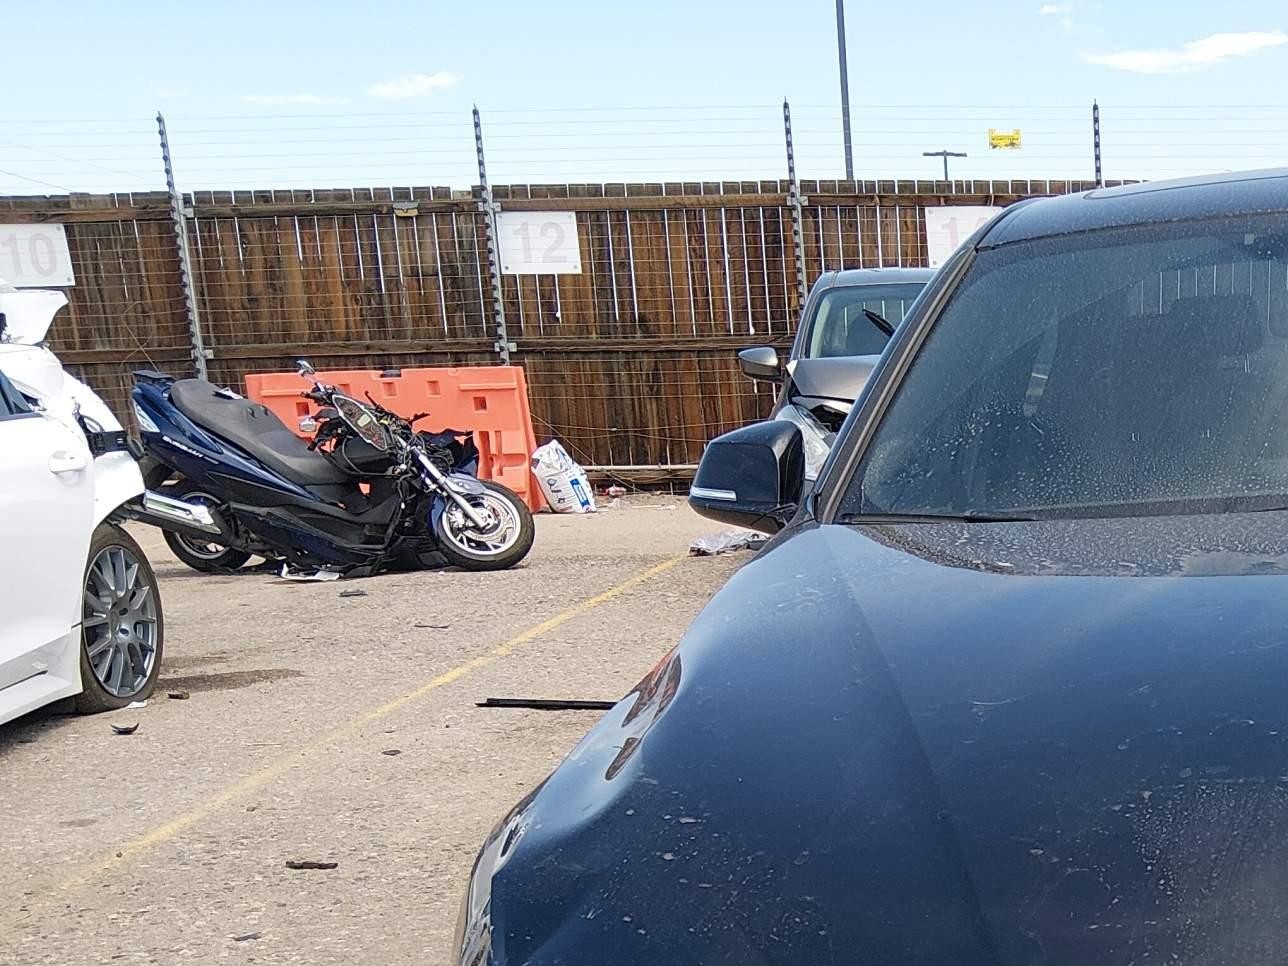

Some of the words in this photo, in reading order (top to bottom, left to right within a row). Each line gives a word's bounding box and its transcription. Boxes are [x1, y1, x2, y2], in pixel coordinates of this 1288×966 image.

[1, 232, 58, 277] 10
[511, 221, 568, 264] 12
[940, 216, 988, 251] 1
